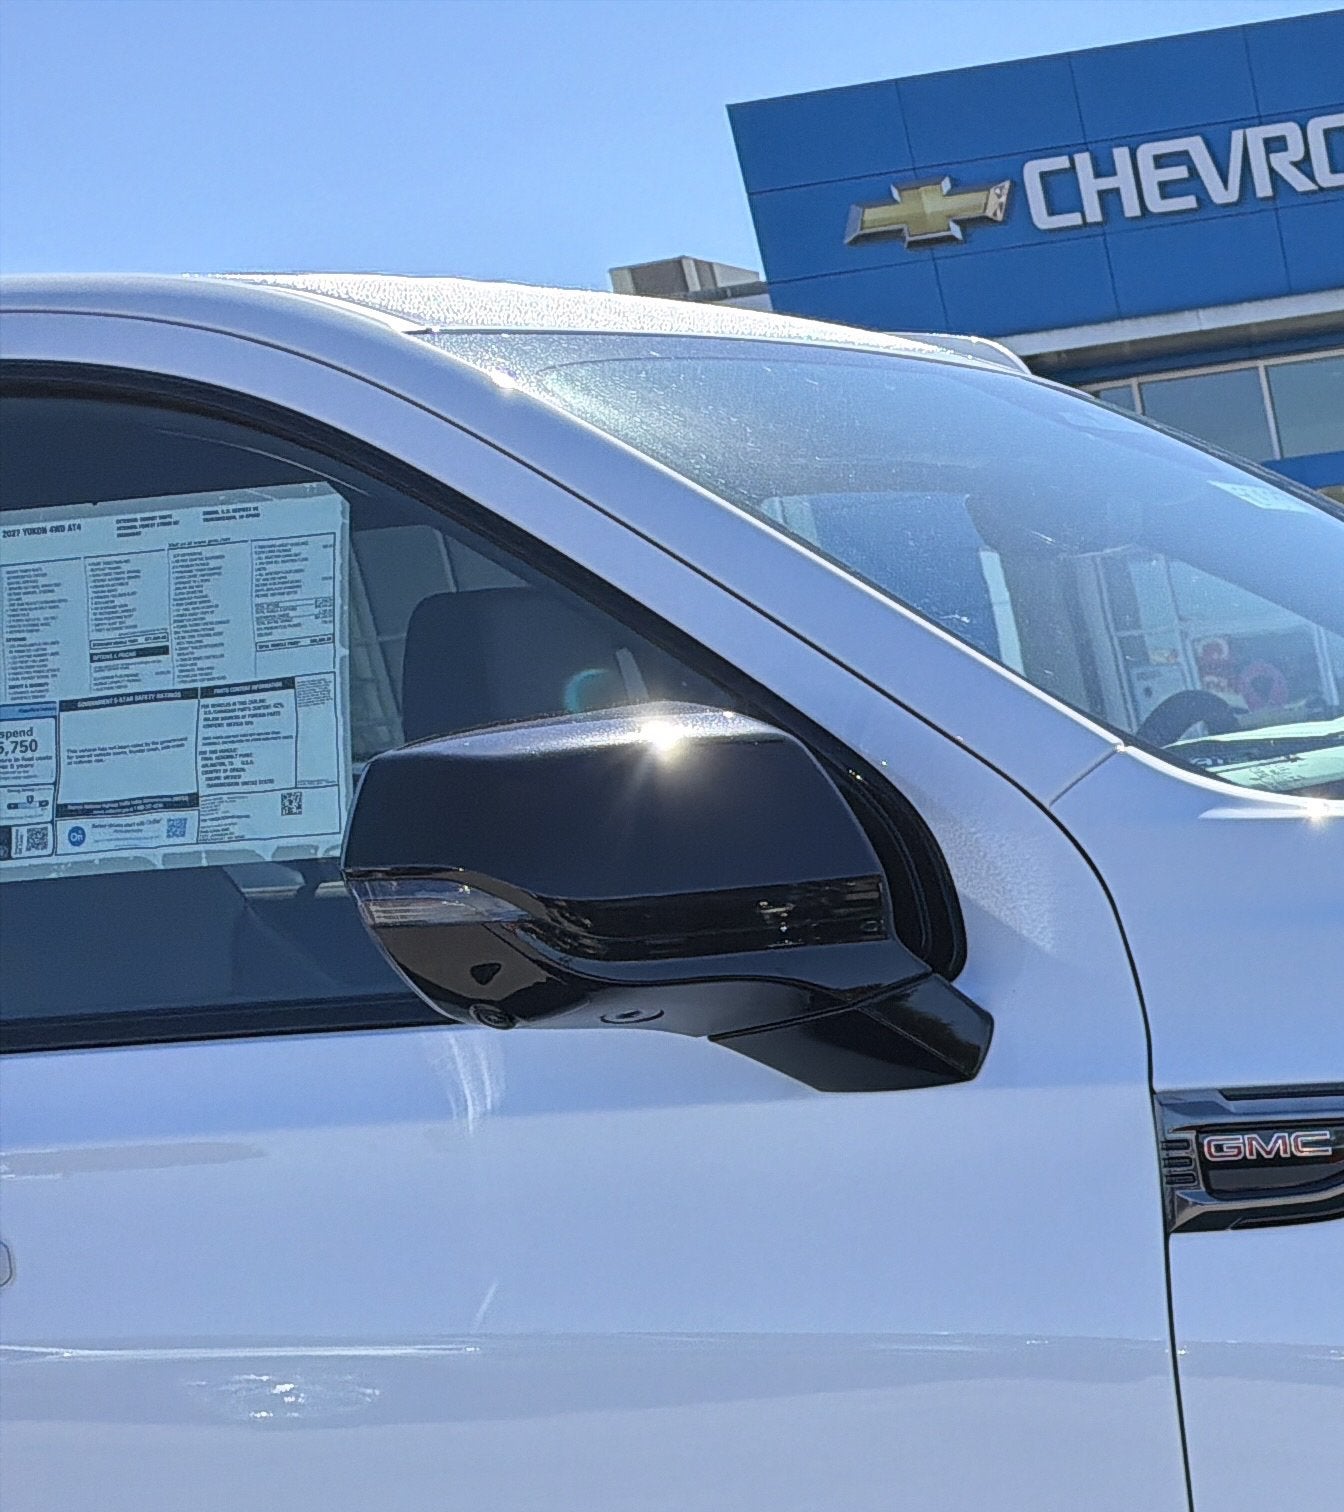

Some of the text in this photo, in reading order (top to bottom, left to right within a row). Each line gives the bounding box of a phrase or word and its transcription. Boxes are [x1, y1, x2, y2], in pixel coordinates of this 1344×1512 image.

[22, 526, 47, 537] YUKON
[67, 523, 82, 532] AT4
[0, 727, 34, 740] spend
[1203, 1130, 1332, 1162] GMC
